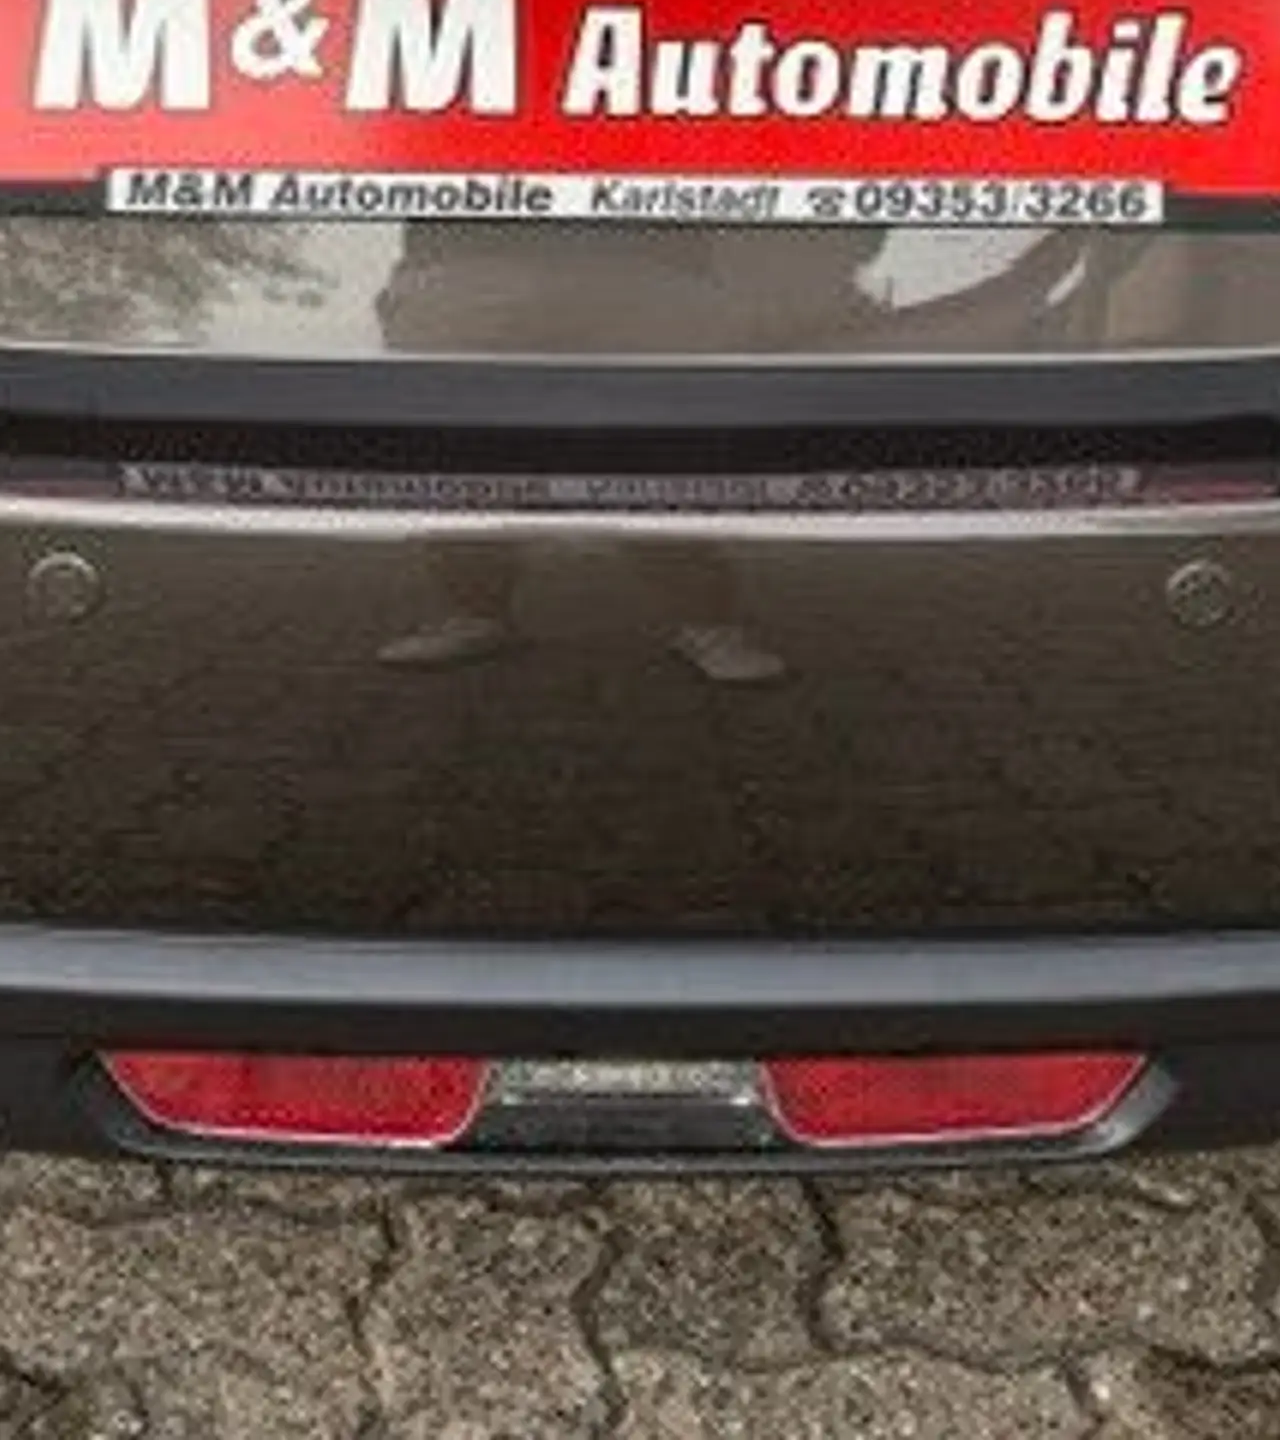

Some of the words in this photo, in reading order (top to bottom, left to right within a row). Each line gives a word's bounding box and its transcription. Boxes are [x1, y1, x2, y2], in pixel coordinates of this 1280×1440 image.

[561, 4, 1244, 122] Automobile
[125, 173, 255, 209] M&M
[267, 175, 554, 213] Automobile
[590, 181, 782, 220] Karlstadt
